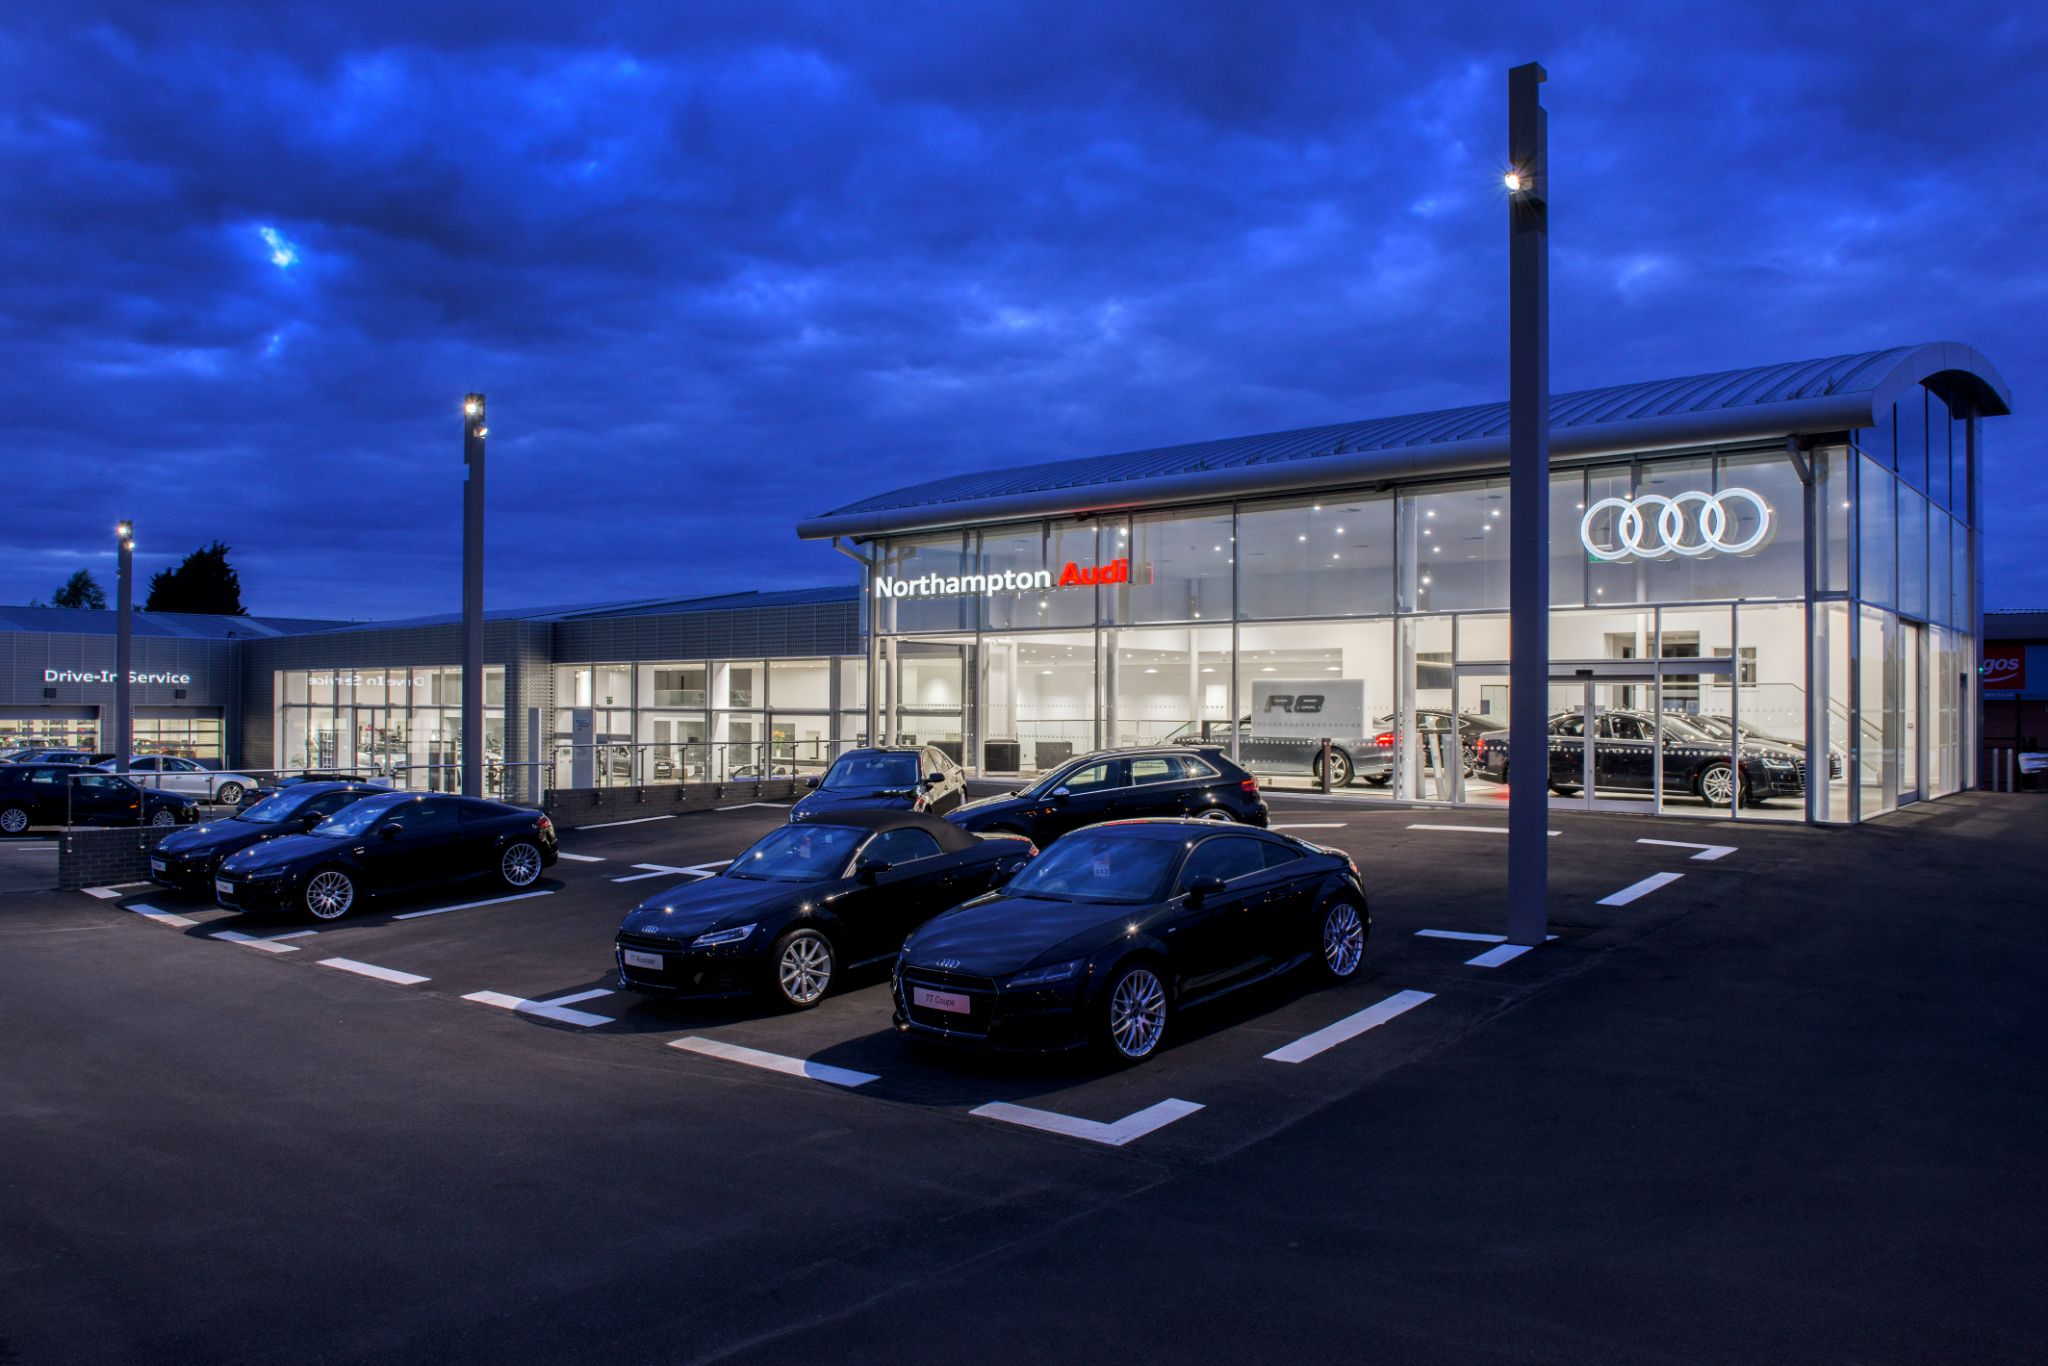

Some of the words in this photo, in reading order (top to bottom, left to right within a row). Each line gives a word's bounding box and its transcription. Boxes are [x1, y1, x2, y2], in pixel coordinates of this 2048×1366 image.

[875, 569, 1051, 598] Northampton
[1058, 557, 1129, 586] Audi
[1983, 658, 2019, 675] gos
[129, 671, 191, 684] Service
[1263, 695, 1325, 713] R8
[925, 993, 934, 1003] TT
